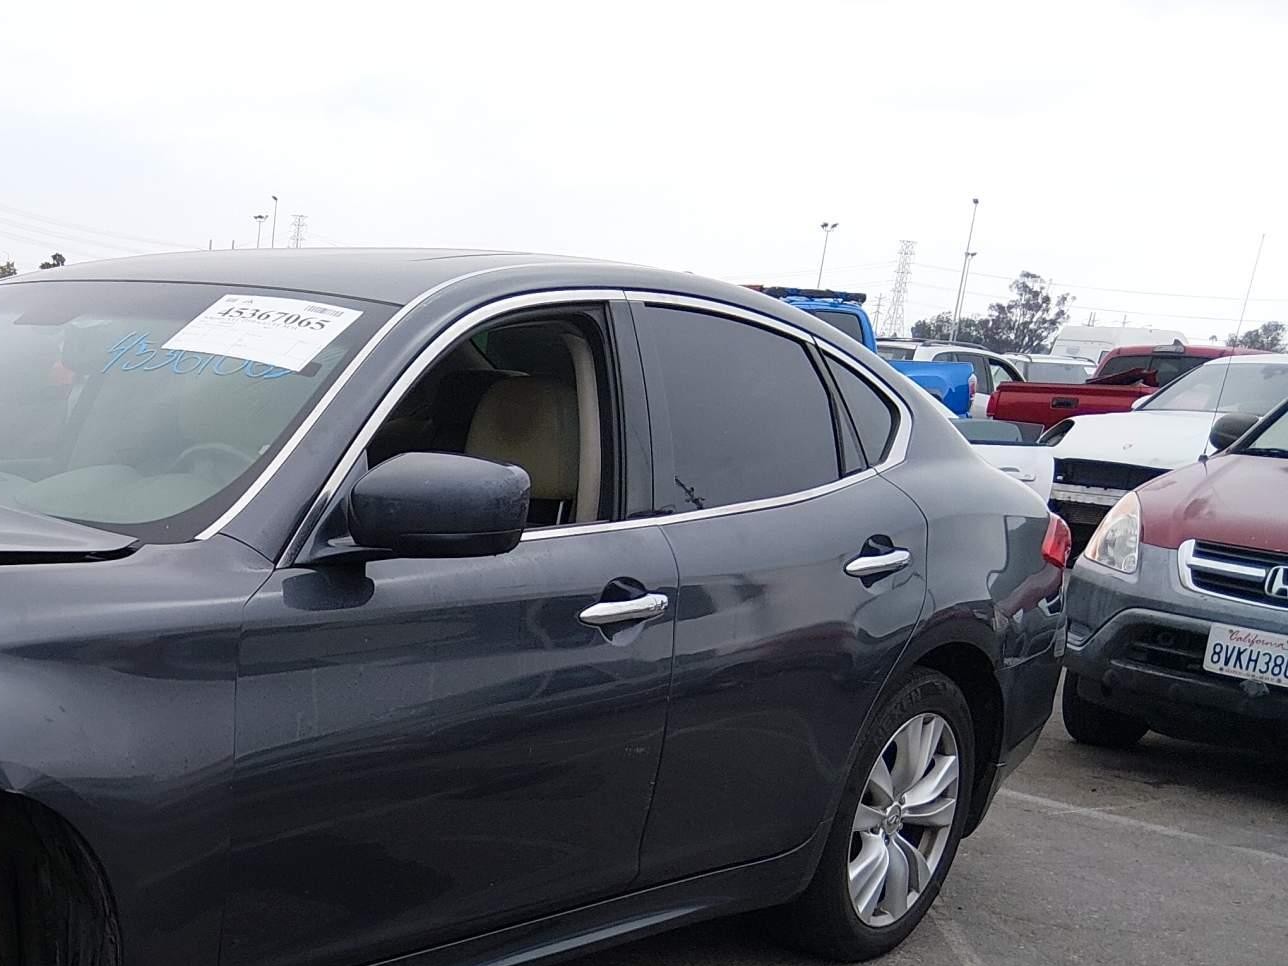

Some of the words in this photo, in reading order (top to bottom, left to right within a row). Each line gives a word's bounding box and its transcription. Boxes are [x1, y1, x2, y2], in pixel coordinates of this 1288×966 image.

[218, 306, 332, 330] 45367065
[101, 330, 293, 379] 4536
[1229, 630, 1285, 650] California
